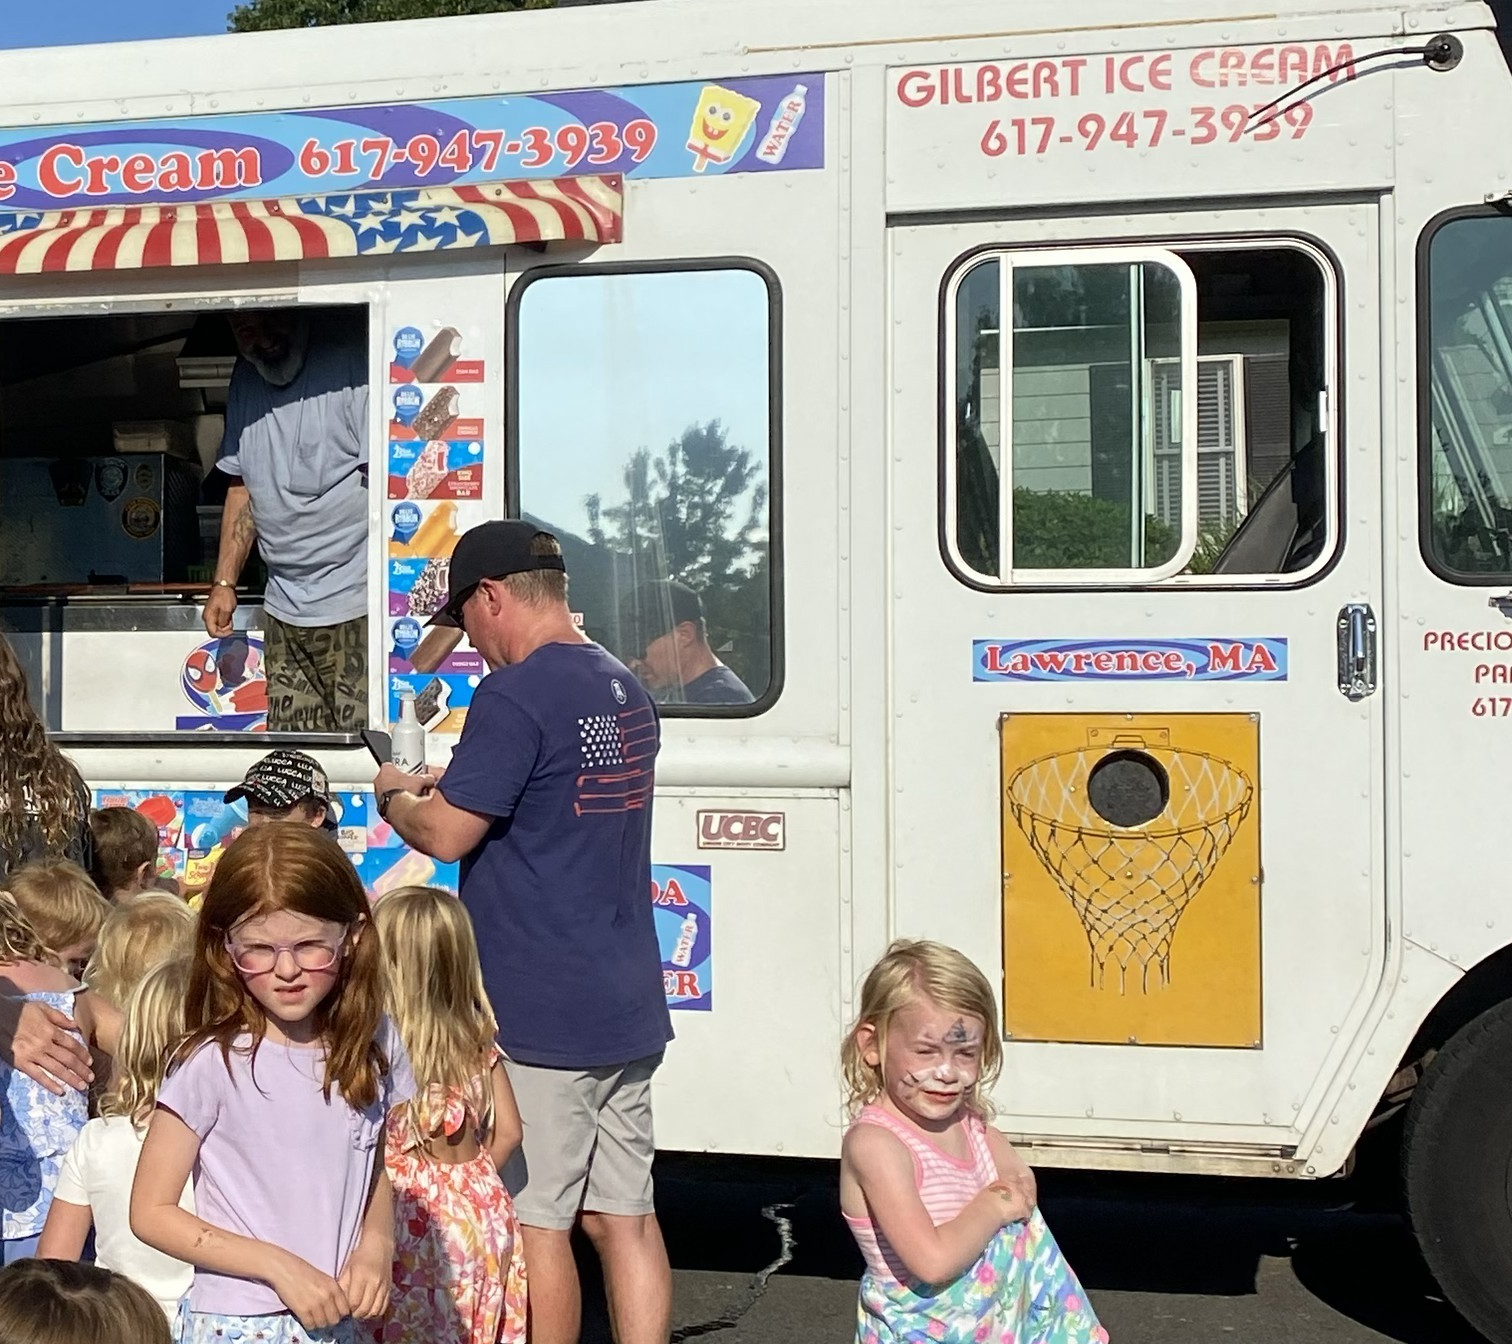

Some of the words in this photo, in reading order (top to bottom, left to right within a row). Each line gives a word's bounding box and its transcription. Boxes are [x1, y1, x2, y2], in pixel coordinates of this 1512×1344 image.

[897, 60, 1087, 108] GILBERT
[1105, 54, 1173, 95] ICE
[1189, 43, 1358, 89] CREAM
[762, 100, 803, 157] WATER
[980, 101, 1314, 157] 617-947-3939
[38, 143, 262, 197] Cream
[298, 118, 659, 182] 617-947-3939
[986, 646, 1197, 680] Lawrence,
[1208, 642, 1278, 674] MA
[701, 814, 782, 842] UCBC
